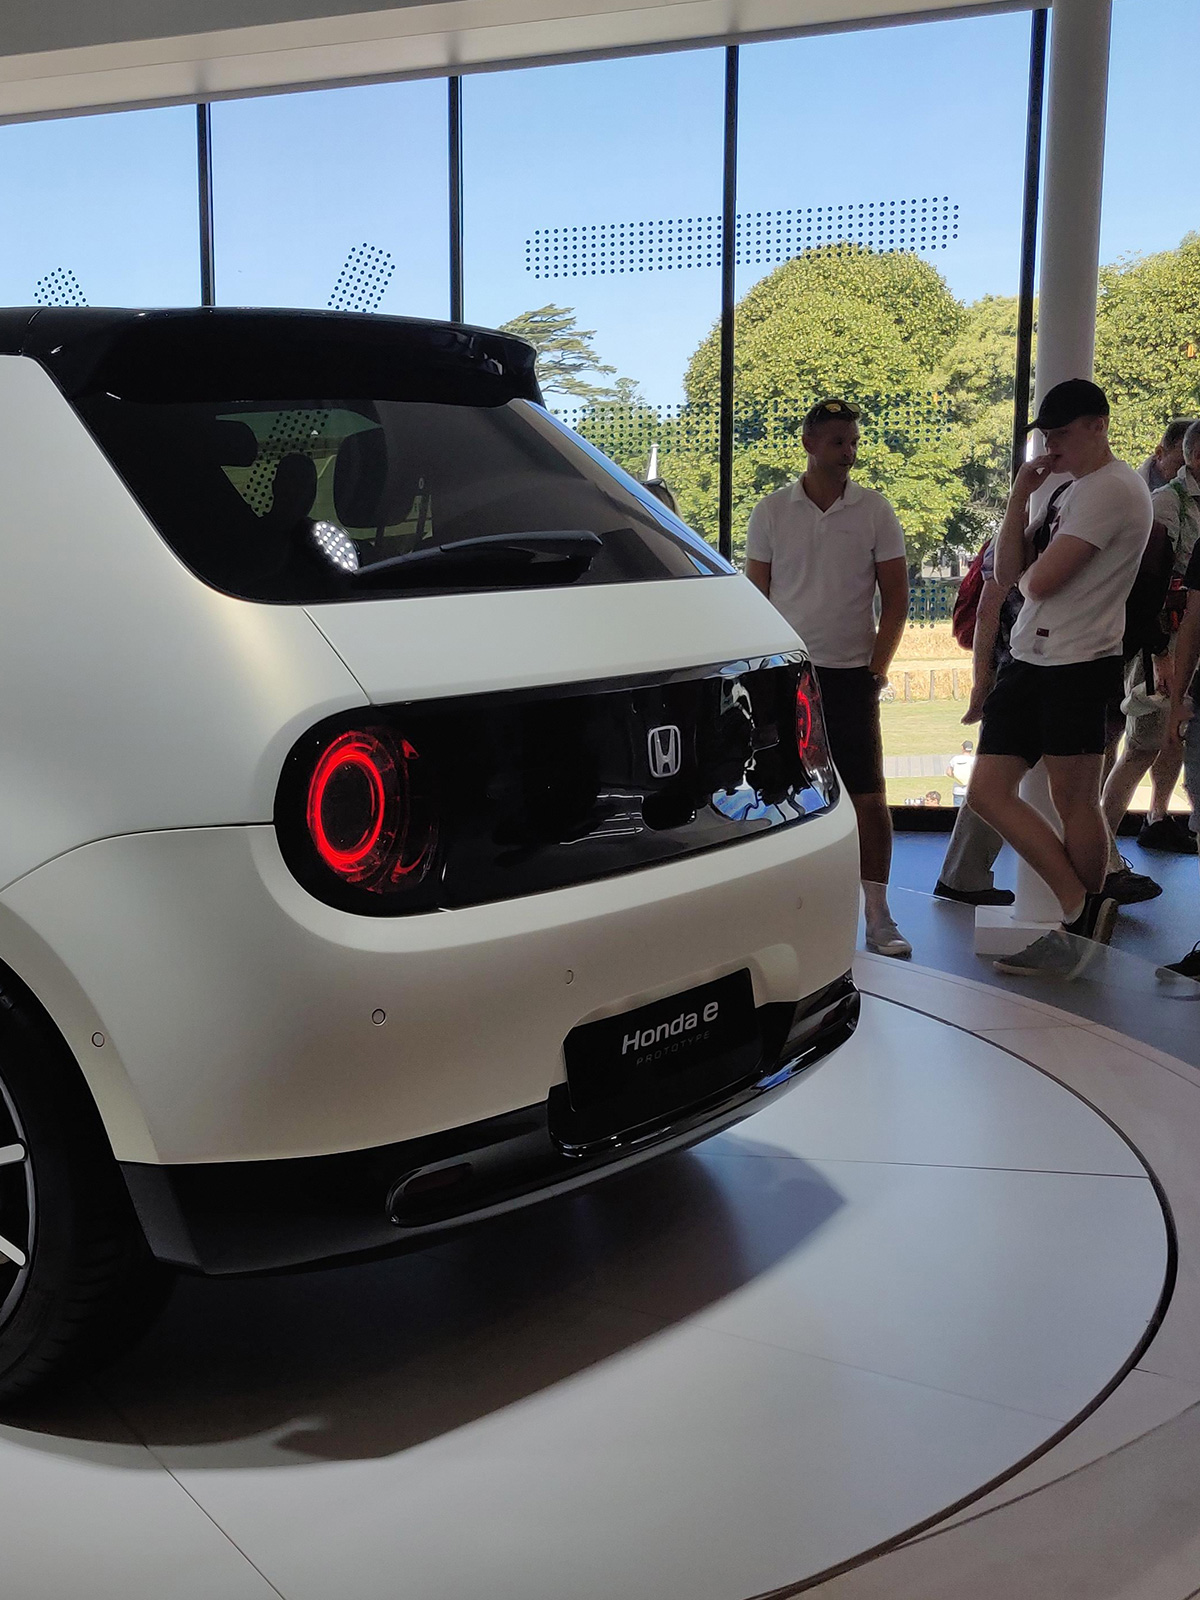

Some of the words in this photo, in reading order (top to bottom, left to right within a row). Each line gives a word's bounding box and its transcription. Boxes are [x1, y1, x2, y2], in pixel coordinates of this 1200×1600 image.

[621, 1012, 699, 1056] Honda
[703, 1000, 720, 1023] e
[636, 1030, 712, 1066] PROTOTYPE
